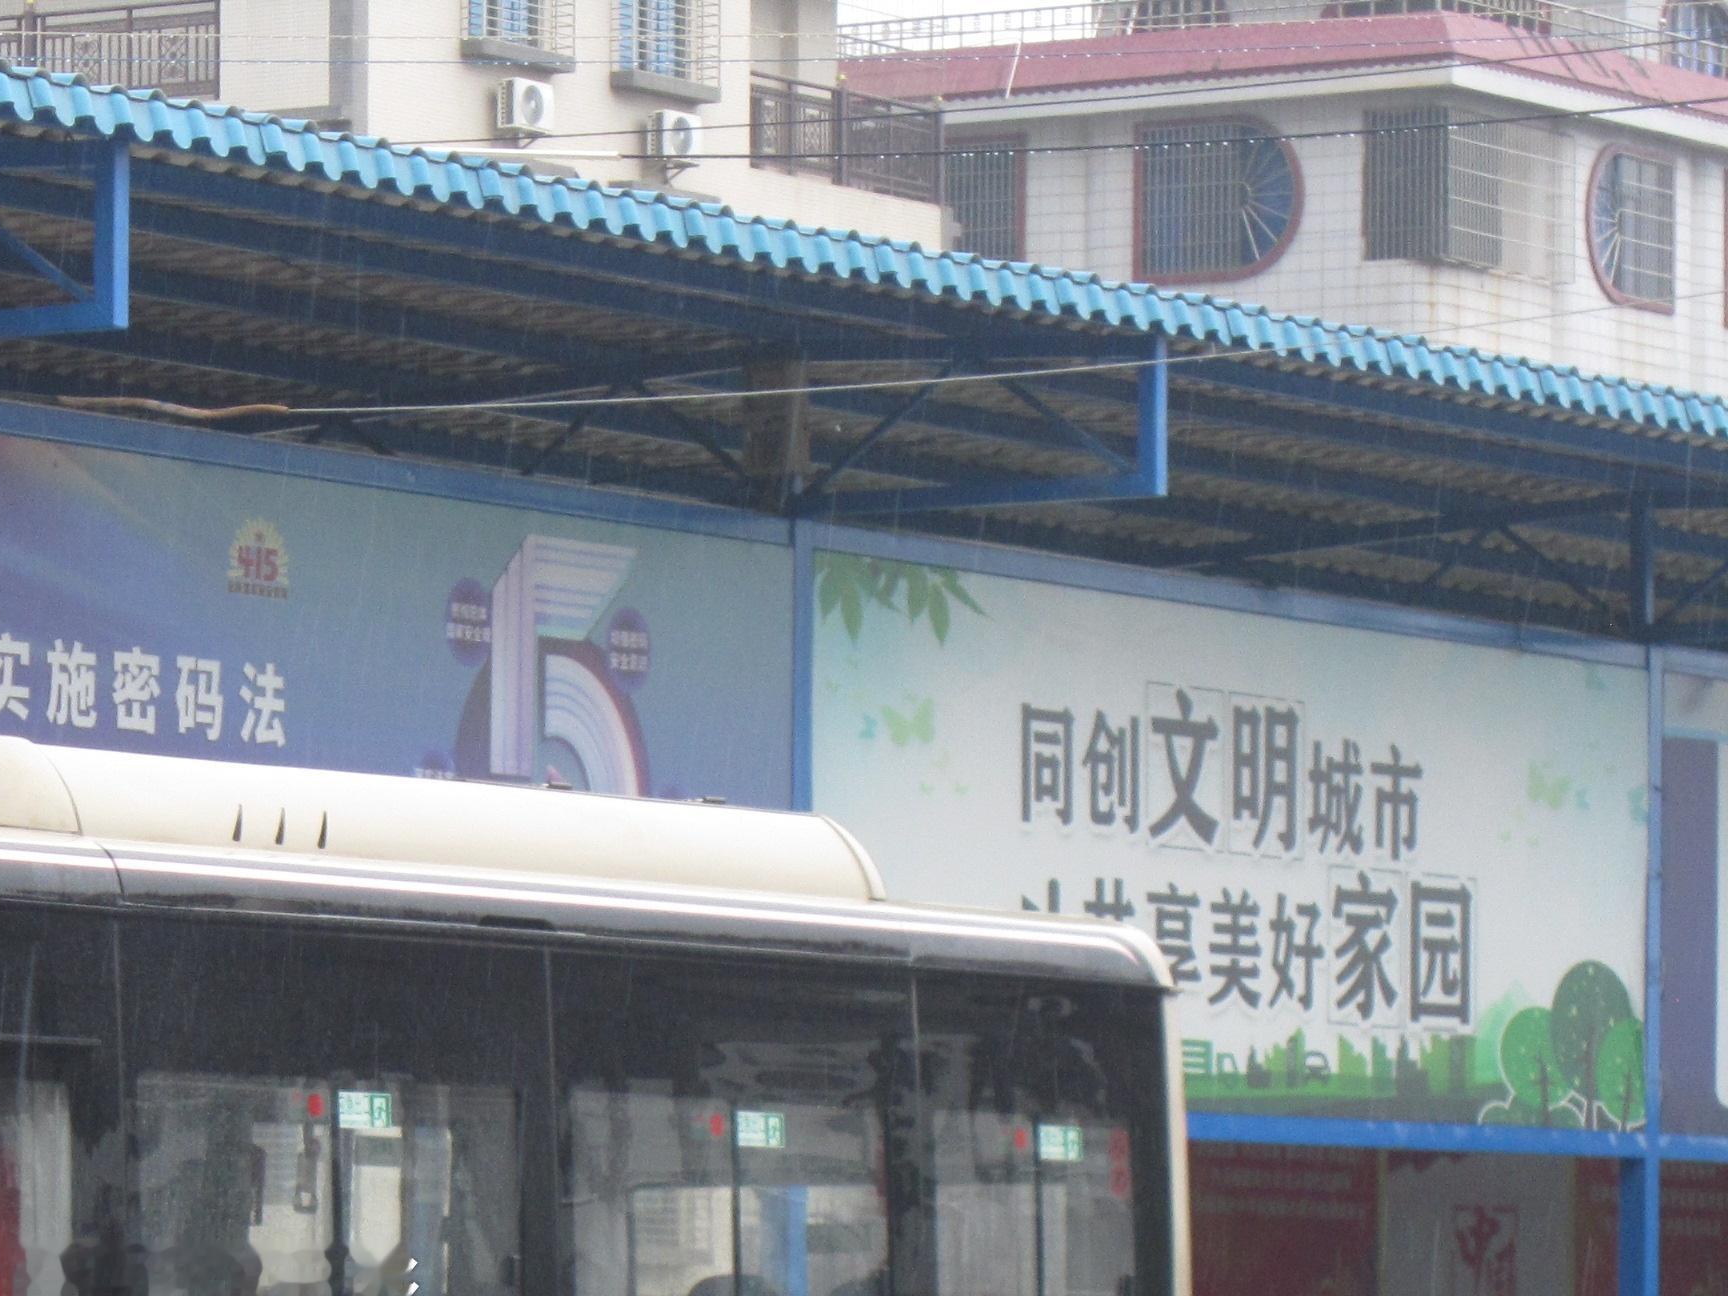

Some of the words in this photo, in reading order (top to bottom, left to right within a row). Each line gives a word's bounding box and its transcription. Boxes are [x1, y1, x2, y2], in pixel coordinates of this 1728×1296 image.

[1020, 687, 1424, 861] 同创文明城市
